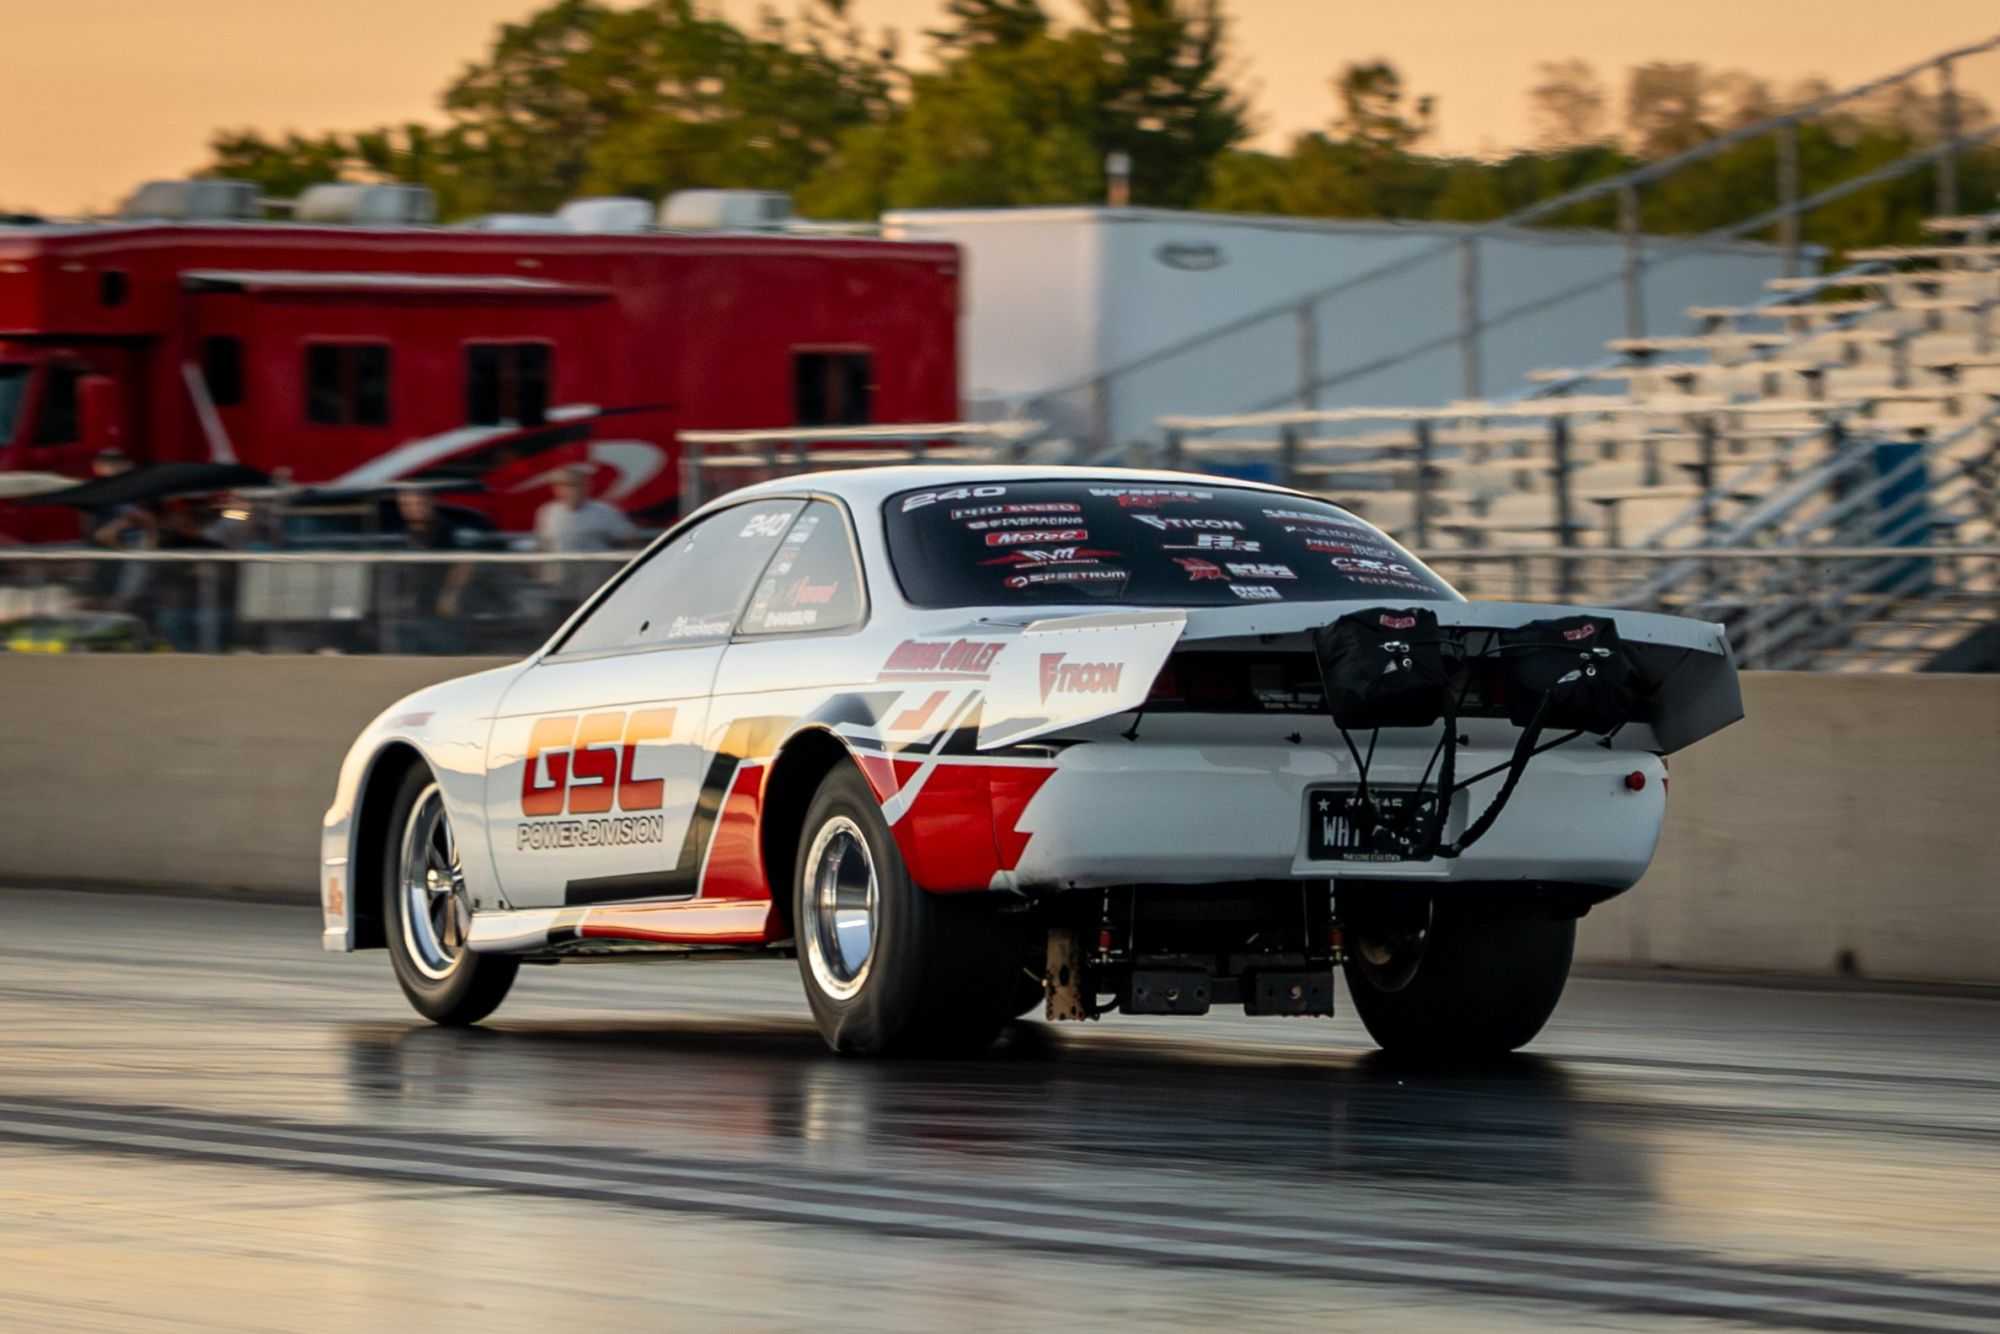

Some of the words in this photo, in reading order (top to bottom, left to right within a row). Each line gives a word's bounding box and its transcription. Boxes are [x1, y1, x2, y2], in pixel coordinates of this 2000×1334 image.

[902, 486, 1006, 512] 240
[739, 513, 791, 537] 240
[1164, 518, 1245, 530] TICON
[1029, 571, 1126, 582] SPECTRUM
[1057, 662, 1124, 694] TICON
[521, 707, 678, 817] GSC
[517, 814, 664, 851] POWER-DIVISION
